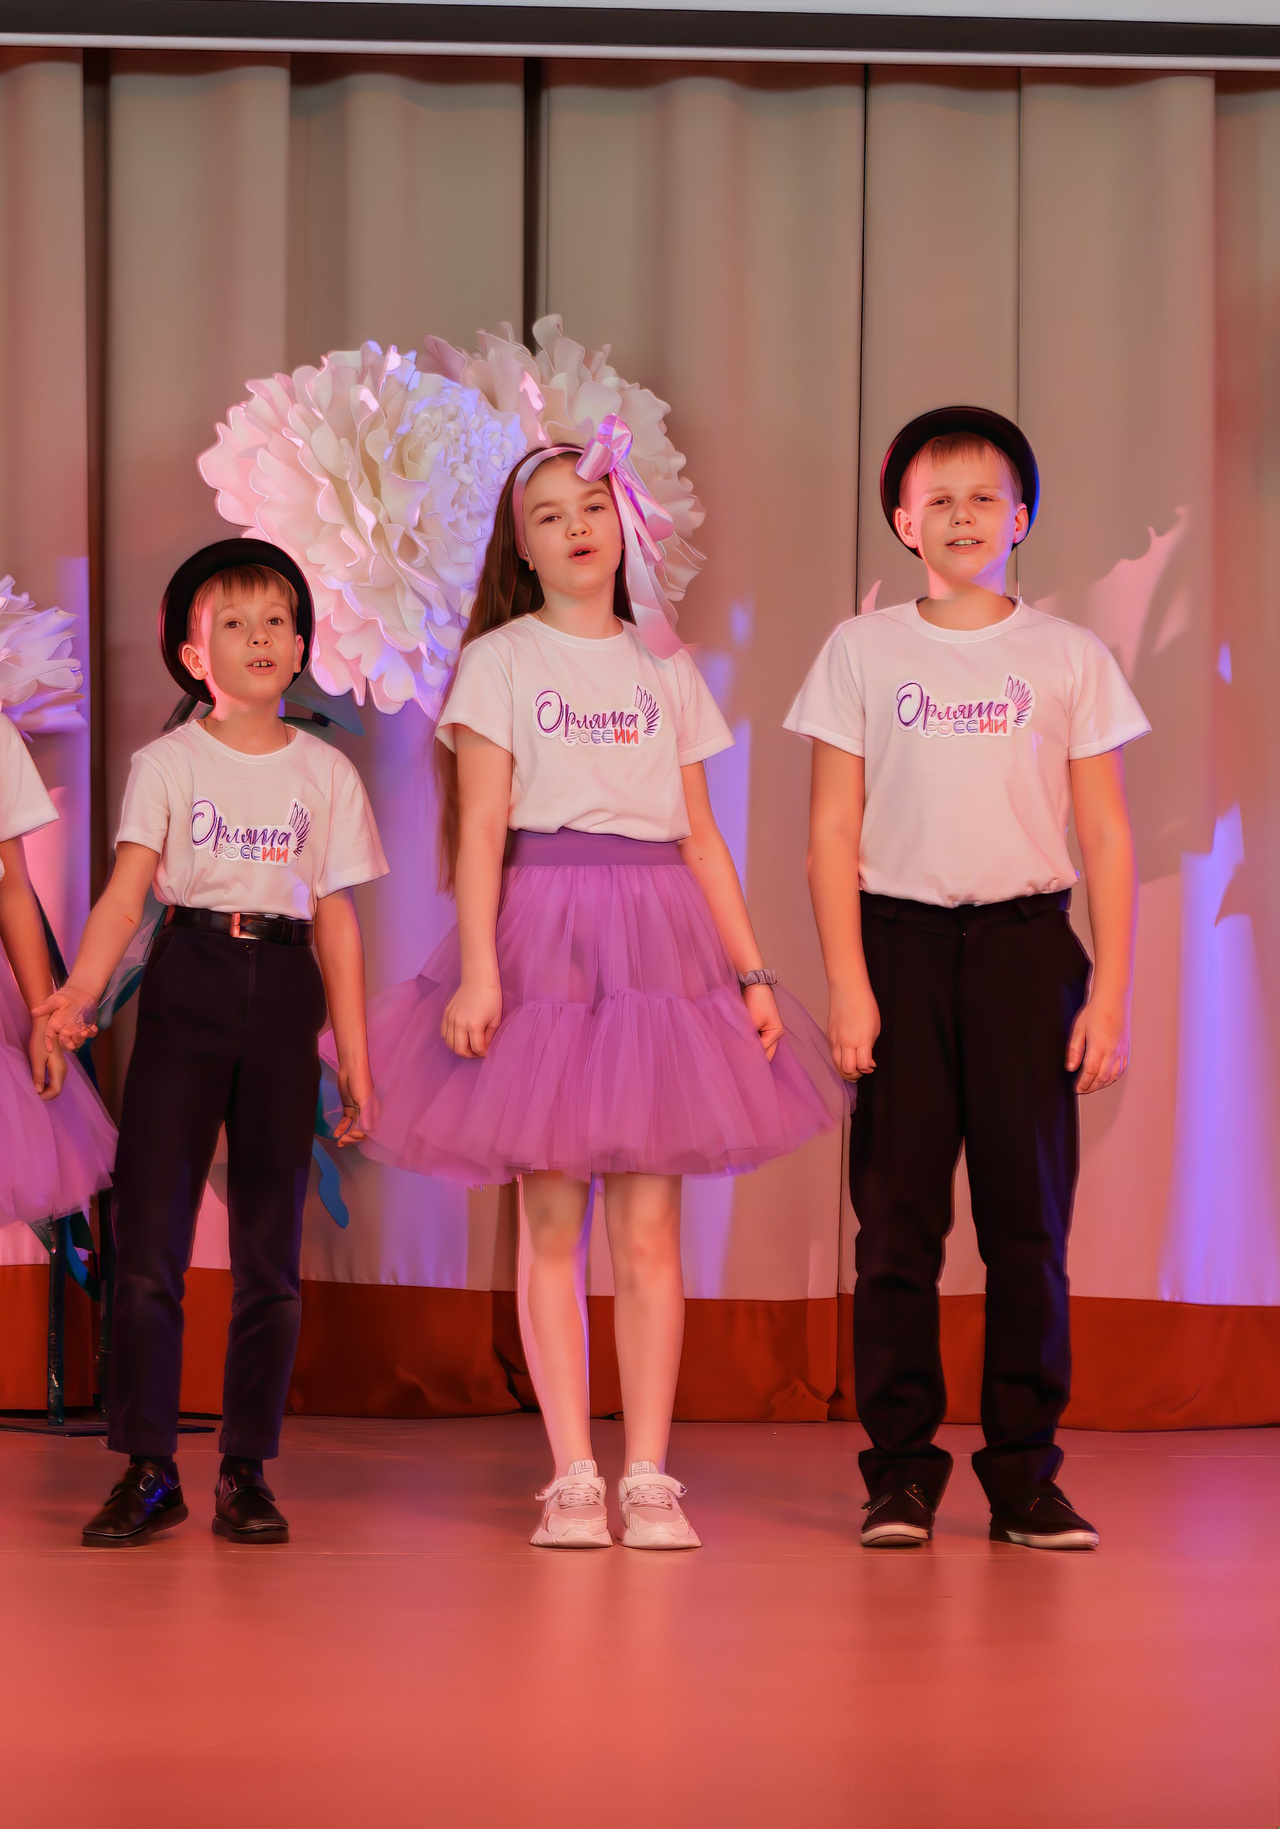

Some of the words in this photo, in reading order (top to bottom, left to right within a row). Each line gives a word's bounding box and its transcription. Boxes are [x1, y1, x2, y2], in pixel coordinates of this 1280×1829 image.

[535, 690, 639, 738] Орлята
[896, 682, 1009, 731] Орлята
[192, 800, 292, 852] Орлята
